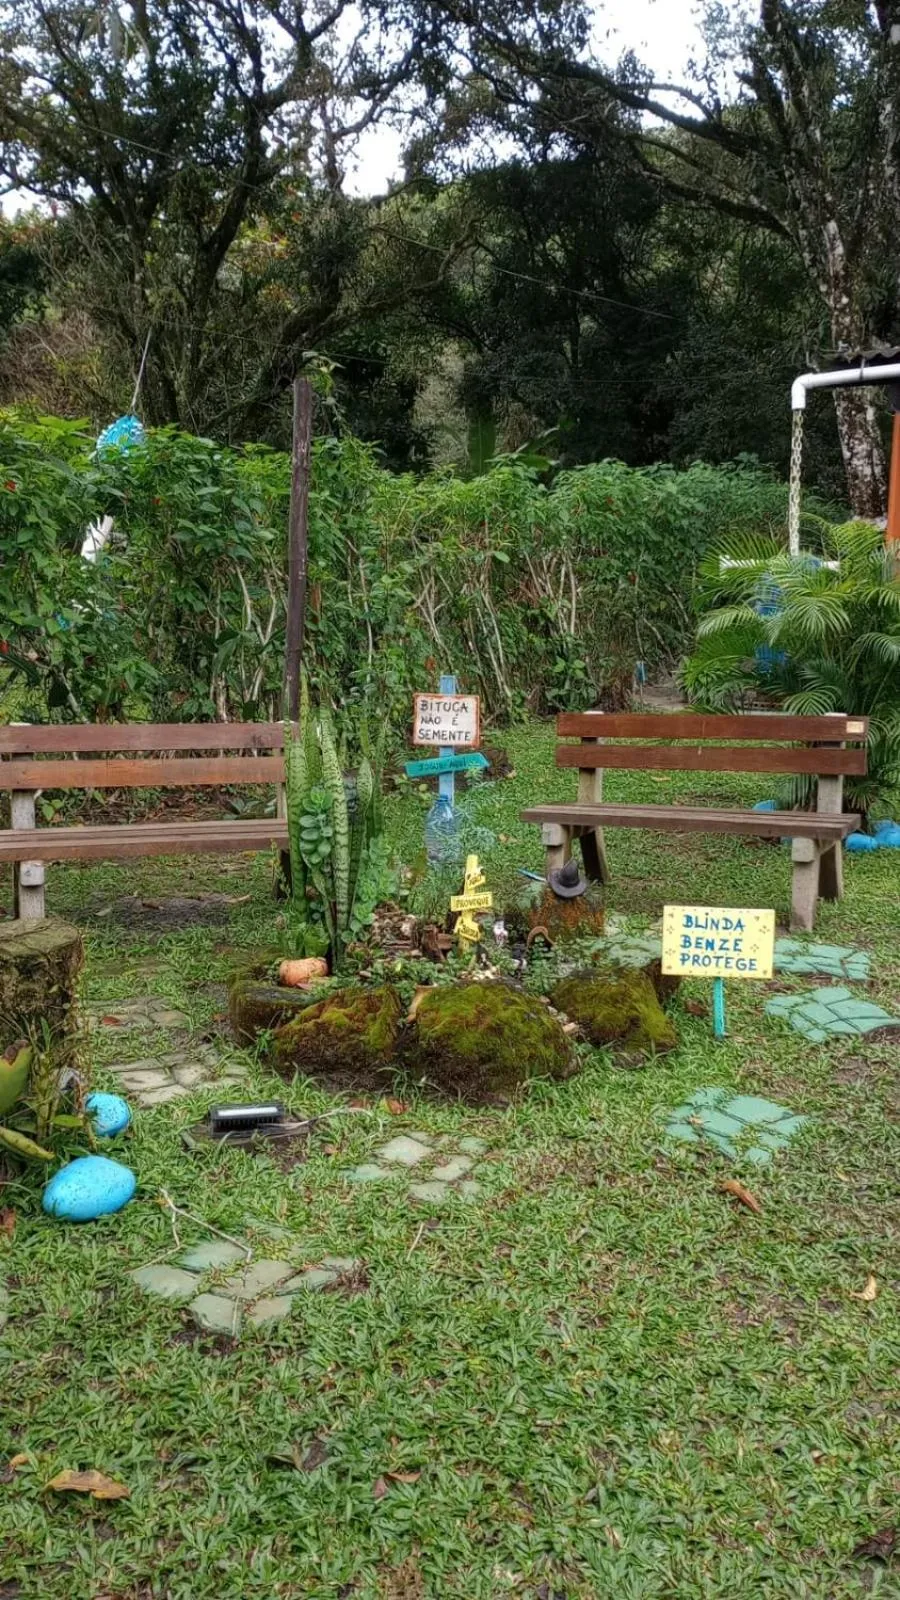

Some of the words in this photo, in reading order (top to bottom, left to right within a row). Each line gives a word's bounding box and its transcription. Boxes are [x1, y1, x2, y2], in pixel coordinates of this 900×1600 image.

[420, 699, 468, 712] BITUCA
[420, 713, 441, 725] NÃO
[451, 712, 459, 726] É
[418, 728, 471, 741] SEMENTE
[682, 912, 745, 932] BLINDA
[680, 934, 743, 952] BENZE
[679, 952, 757, 971] PROTEGE
